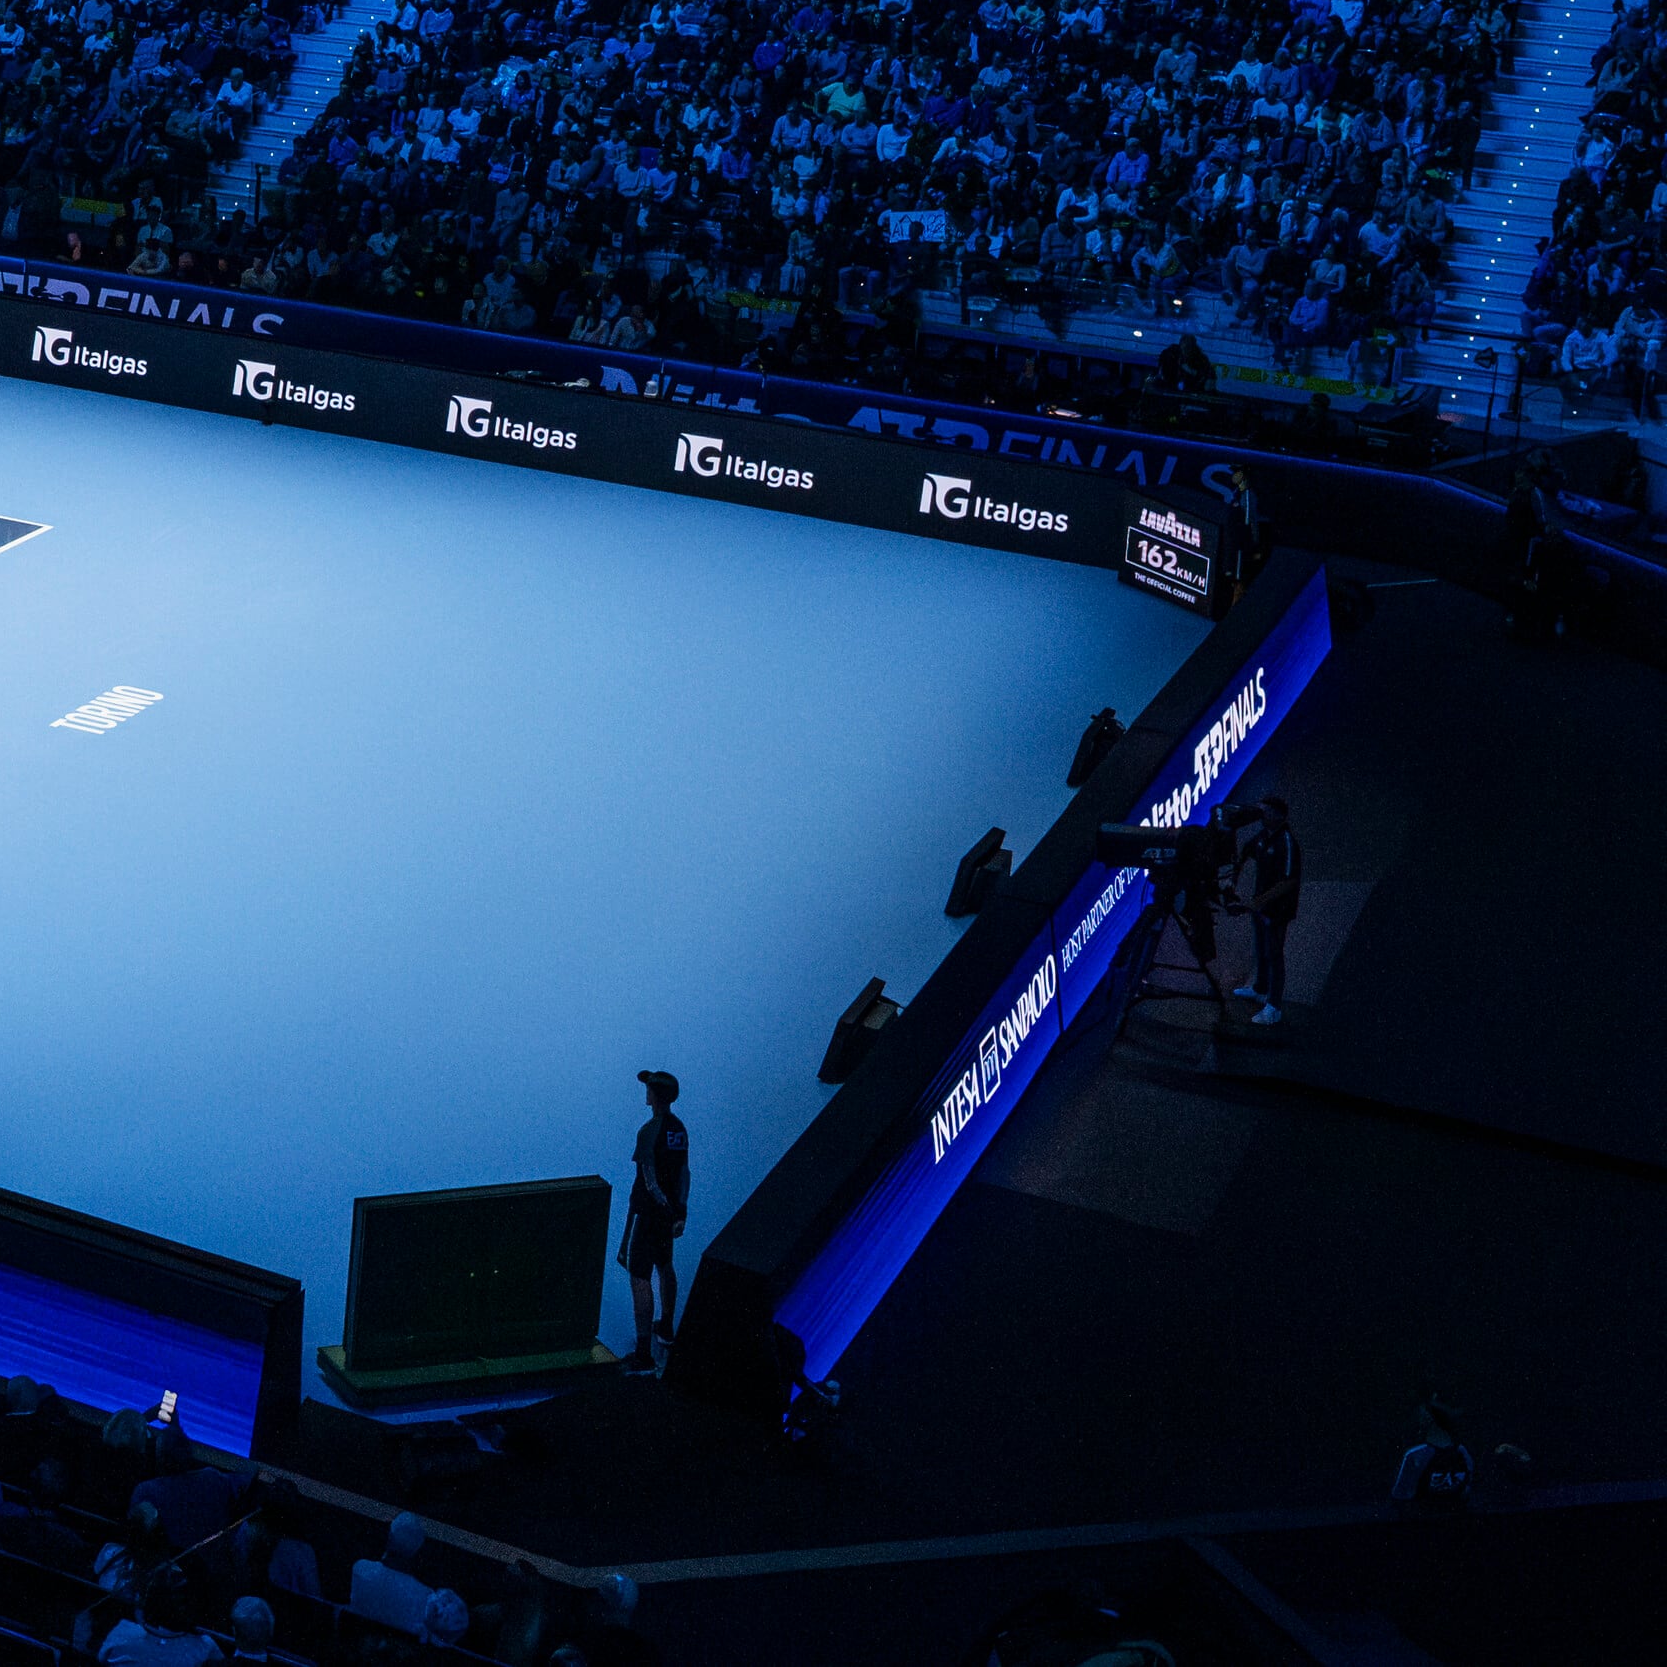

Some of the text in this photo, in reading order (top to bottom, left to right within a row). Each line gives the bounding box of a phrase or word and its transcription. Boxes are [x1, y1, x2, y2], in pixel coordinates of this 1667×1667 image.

[73, 344, 149, 379] Italgas
[277, 379, 357, 415] Italgas
[493, 413, 579, 452] Italgas
[725, 453, 815, 492] Italgas
[974, 494, 1069, 534] Italgas
[1138, 507, 1201, 548] LAVAZZA
[49, 685, 165, 736] TORINO
[929, 870, 1128, 1166] INTESA SANPAOLO HOST PARTNER OF
